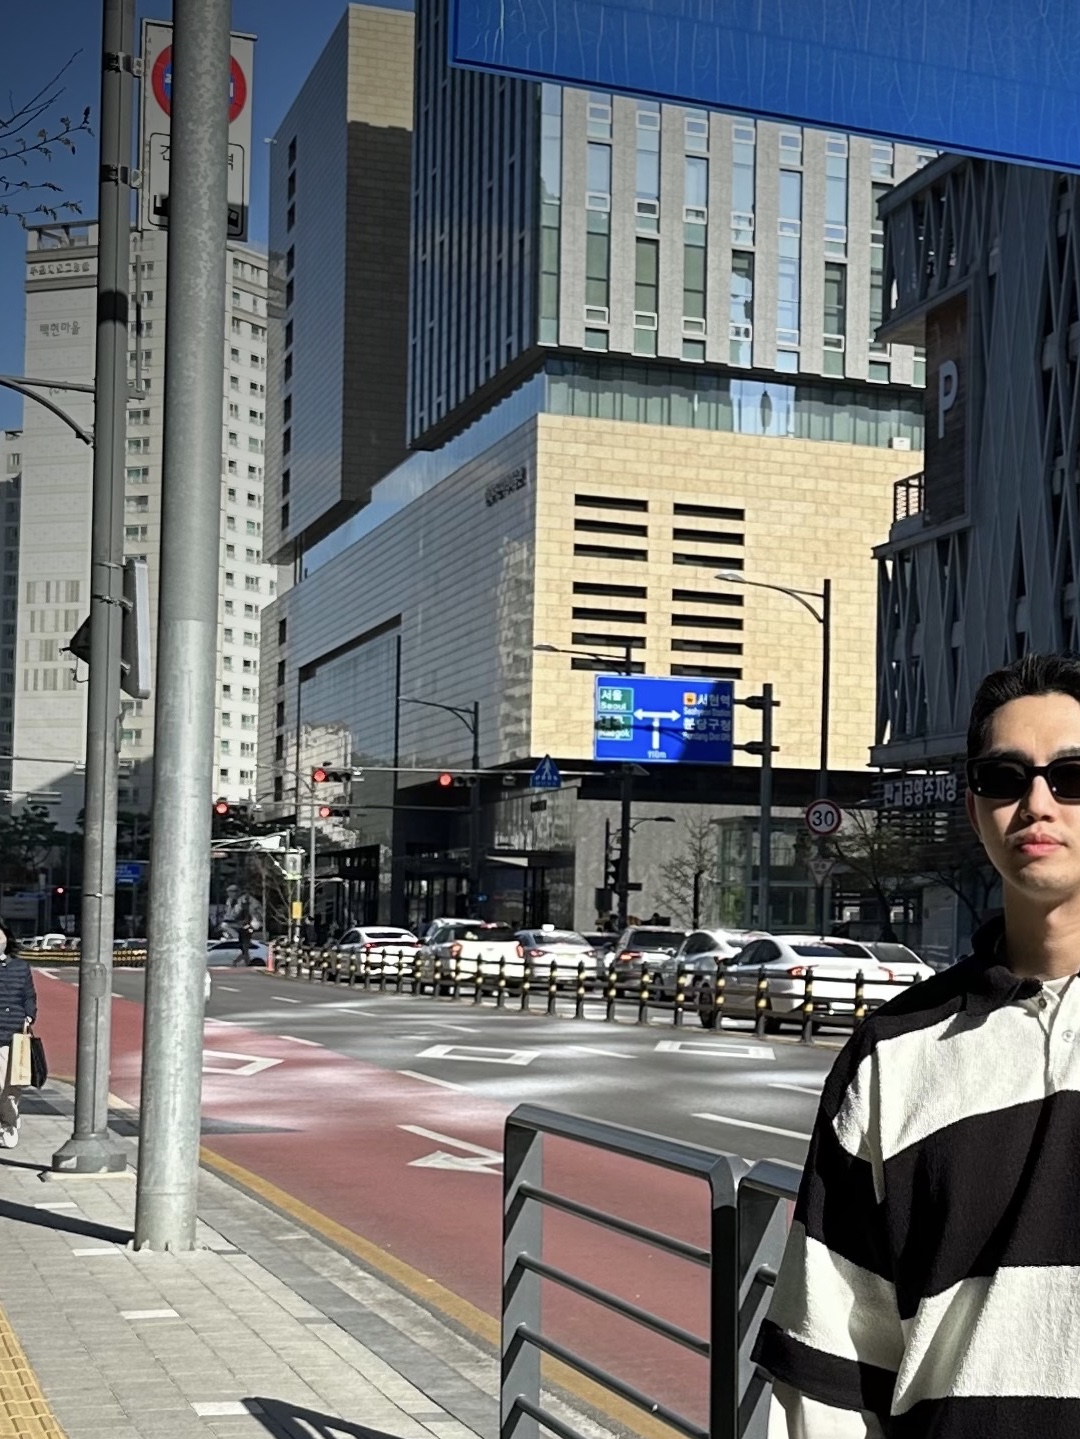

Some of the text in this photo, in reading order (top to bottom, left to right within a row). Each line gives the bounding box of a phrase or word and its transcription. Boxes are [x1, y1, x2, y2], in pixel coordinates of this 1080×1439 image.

[938, 360, 958, 439] P
[601, 689, 623, 701] 서울
[697, 693, 730, 707] 서현역
[600, 701, 627, 711] Seoul
[683, 717, 731, 731] 분당구청
[883, 774, 957, 808] 판교공영주차장
[812, 810, 835, 827] 30
